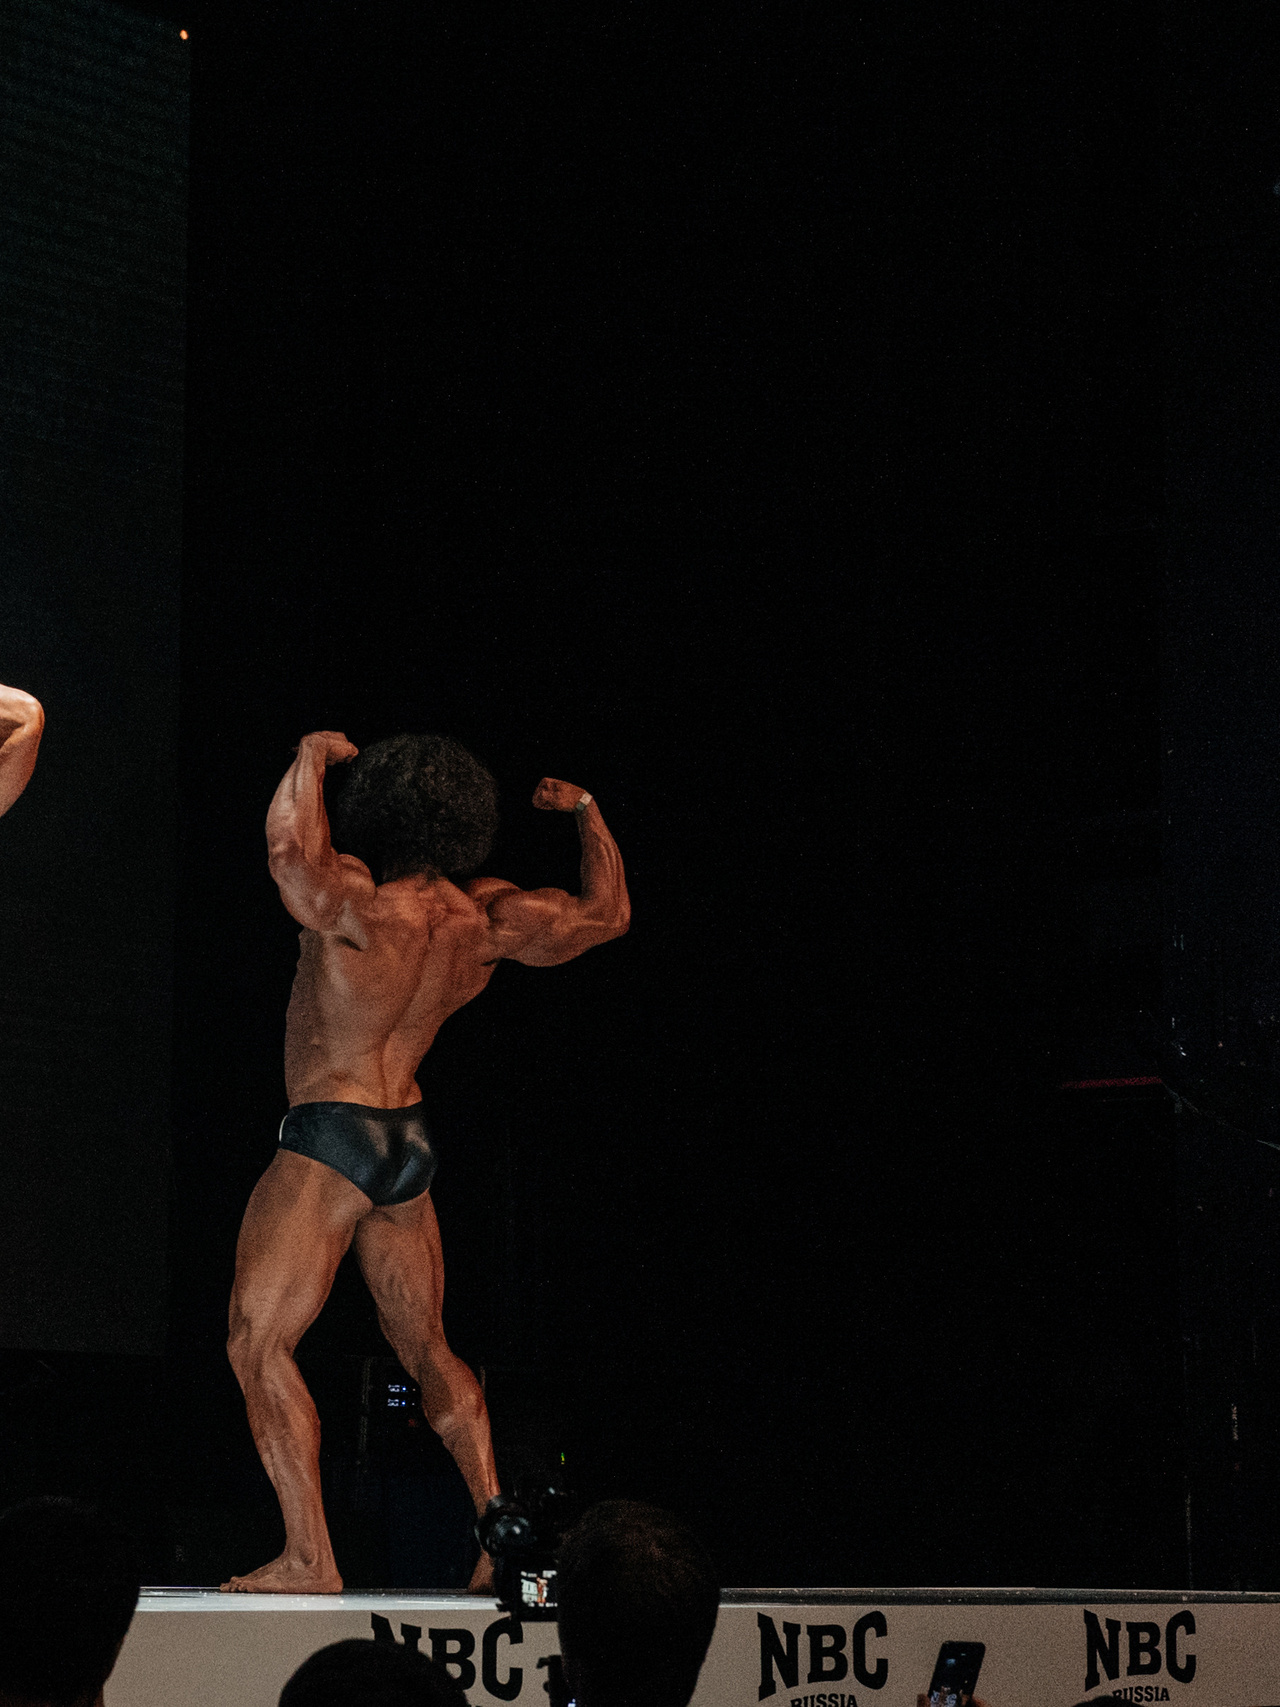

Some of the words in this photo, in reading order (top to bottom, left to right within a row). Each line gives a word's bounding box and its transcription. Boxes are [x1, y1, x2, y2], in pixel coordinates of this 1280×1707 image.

[757, 1611, 888, 1702] NBC
[1083, 1609, 1196, 1692] NBC
[1111, 1685, 1170, 1702] RUSSIA
